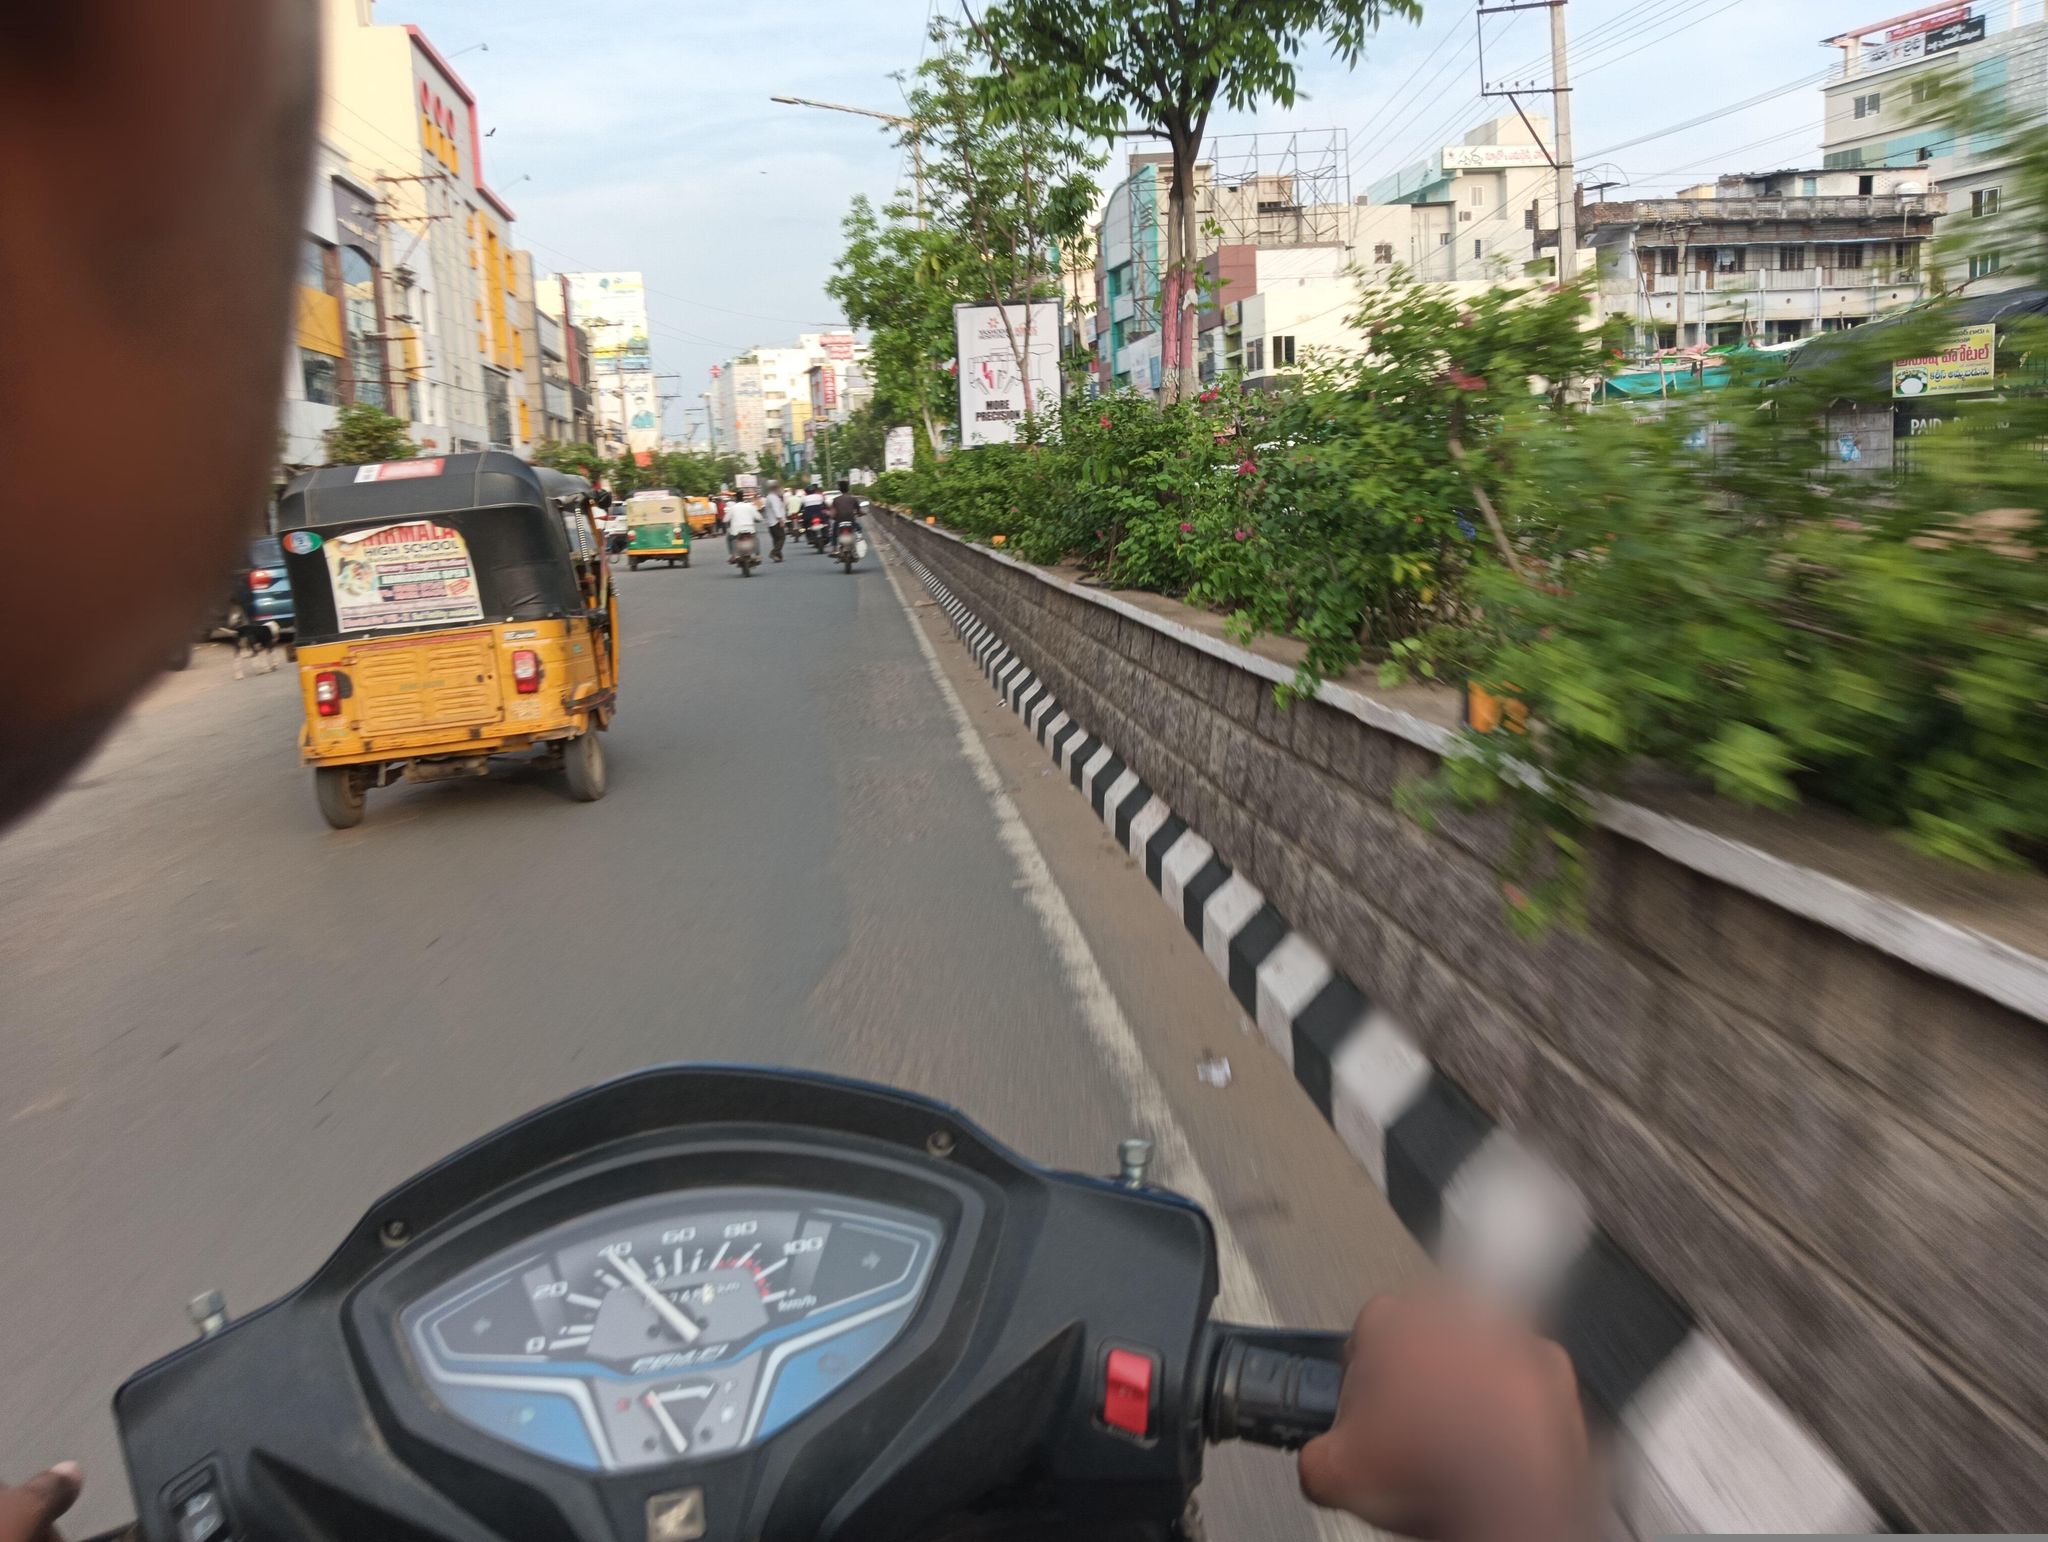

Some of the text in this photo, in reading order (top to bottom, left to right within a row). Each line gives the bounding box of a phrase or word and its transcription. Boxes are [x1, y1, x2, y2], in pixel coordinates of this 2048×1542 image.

[986, 400, 1009, 410] MORE
[976, 410, 1021, 421] PRECISION
[363, 540, 460, 556] HIGH SCHOOL
[662, 1219, 759, 1245] 60 80
[599, 1236, 824, 1257] 40 100
[533, 1281, 568, 1299] 20
[777, 1294, 817, 1312] km/h
[526, 1336, 545, 1354] 0
